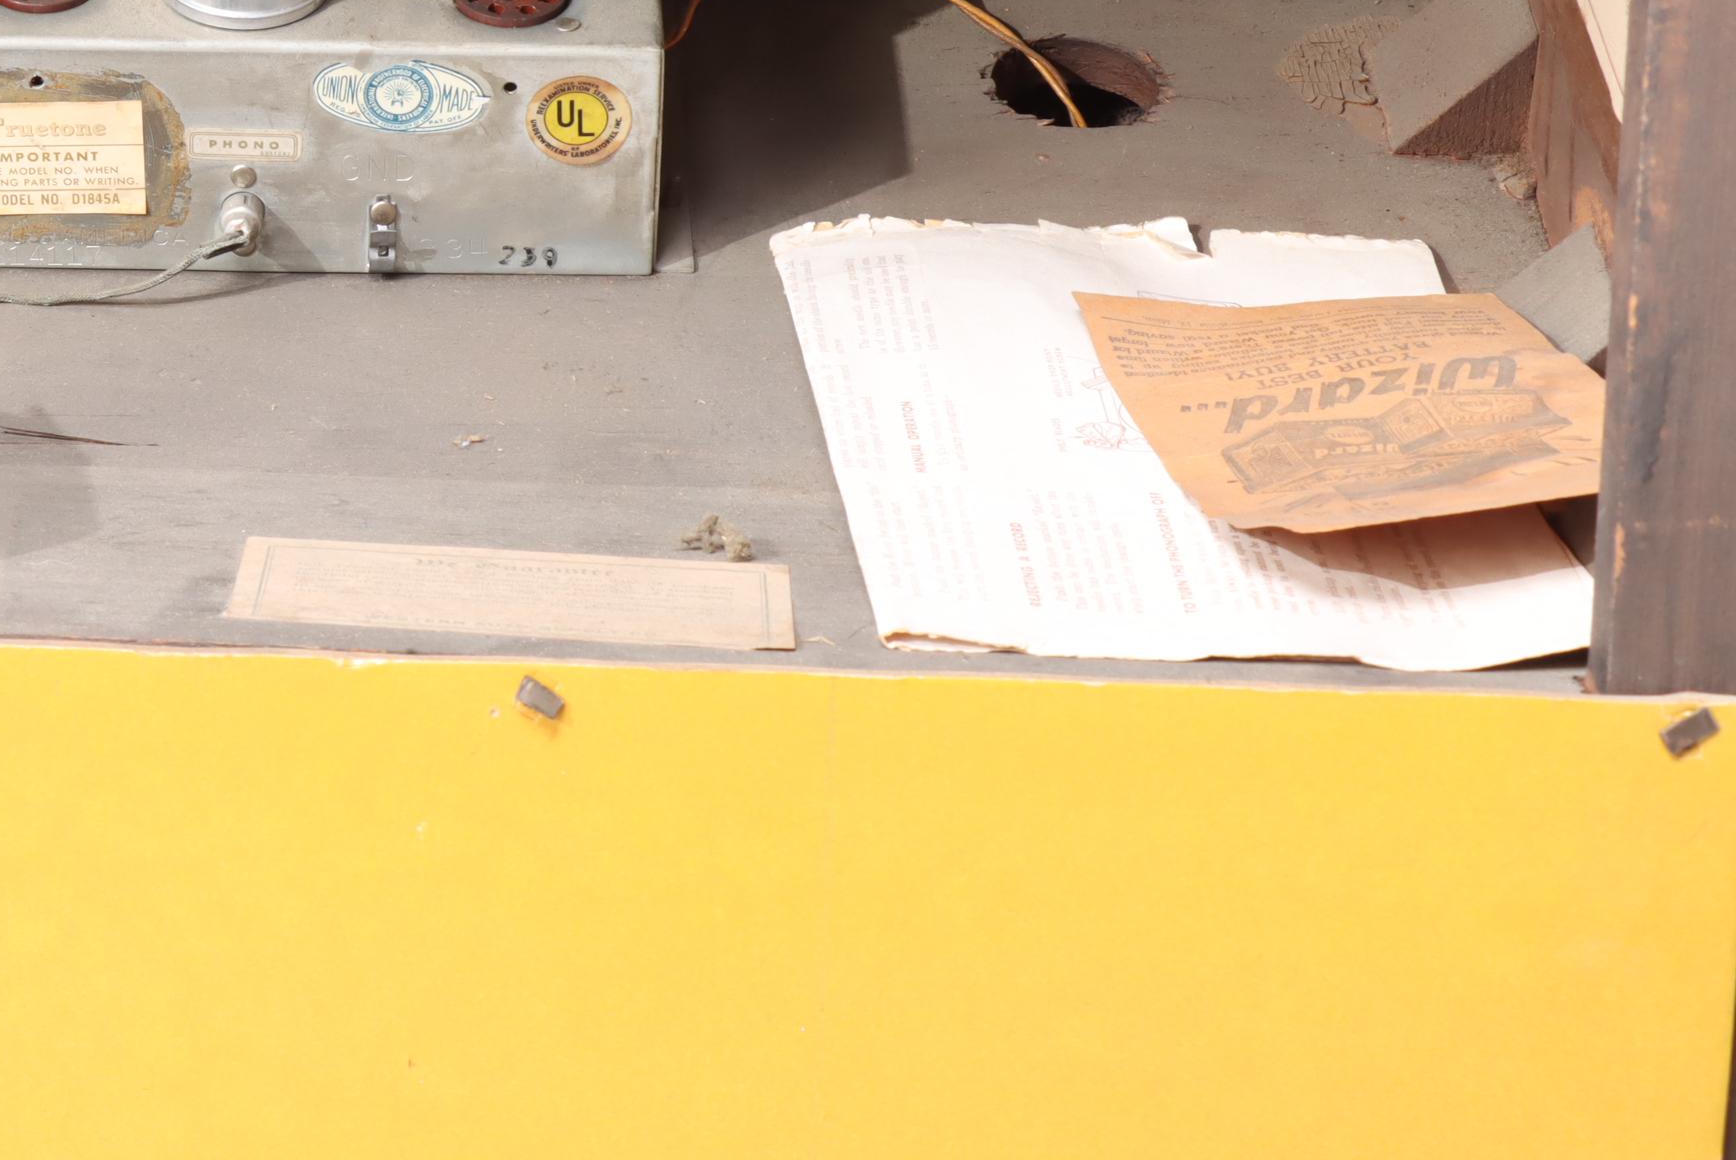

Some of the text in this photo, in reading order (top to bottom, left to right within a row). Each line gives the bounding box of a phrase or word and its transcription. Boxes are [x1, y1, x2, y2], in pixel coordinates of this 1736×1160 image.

[322, 75, 475, 113] UNION MADE
[556, 100, 595, 137] UL
[208, 139, 280, 150] PHONO
[8, 166, 49, 175] MODEL
[83, 166, 119, 175] WHEN
[23, 178, 58, 187] PARTS
[63, 178, 80, 187] OR
[84, 176, 139, 186] WRITING.
[340, 153, 415, 182] GND
[40, 193, 63, 206] NO.
[71, 192, 121, 205] D1845A
[1223, 340, 1431, 382] BATTERY BUY!
[1256, 351, 1419, 391] YOUR BEST
[900, 401, 929, 473] MANUAL OPERATION
[1009, 522, 1028, 551] RECORD
[1148, 492, 1200, 614] TO TURN THE PHONOGRAPH OFF
[1019, 566, 1042, 608] REJECTING
